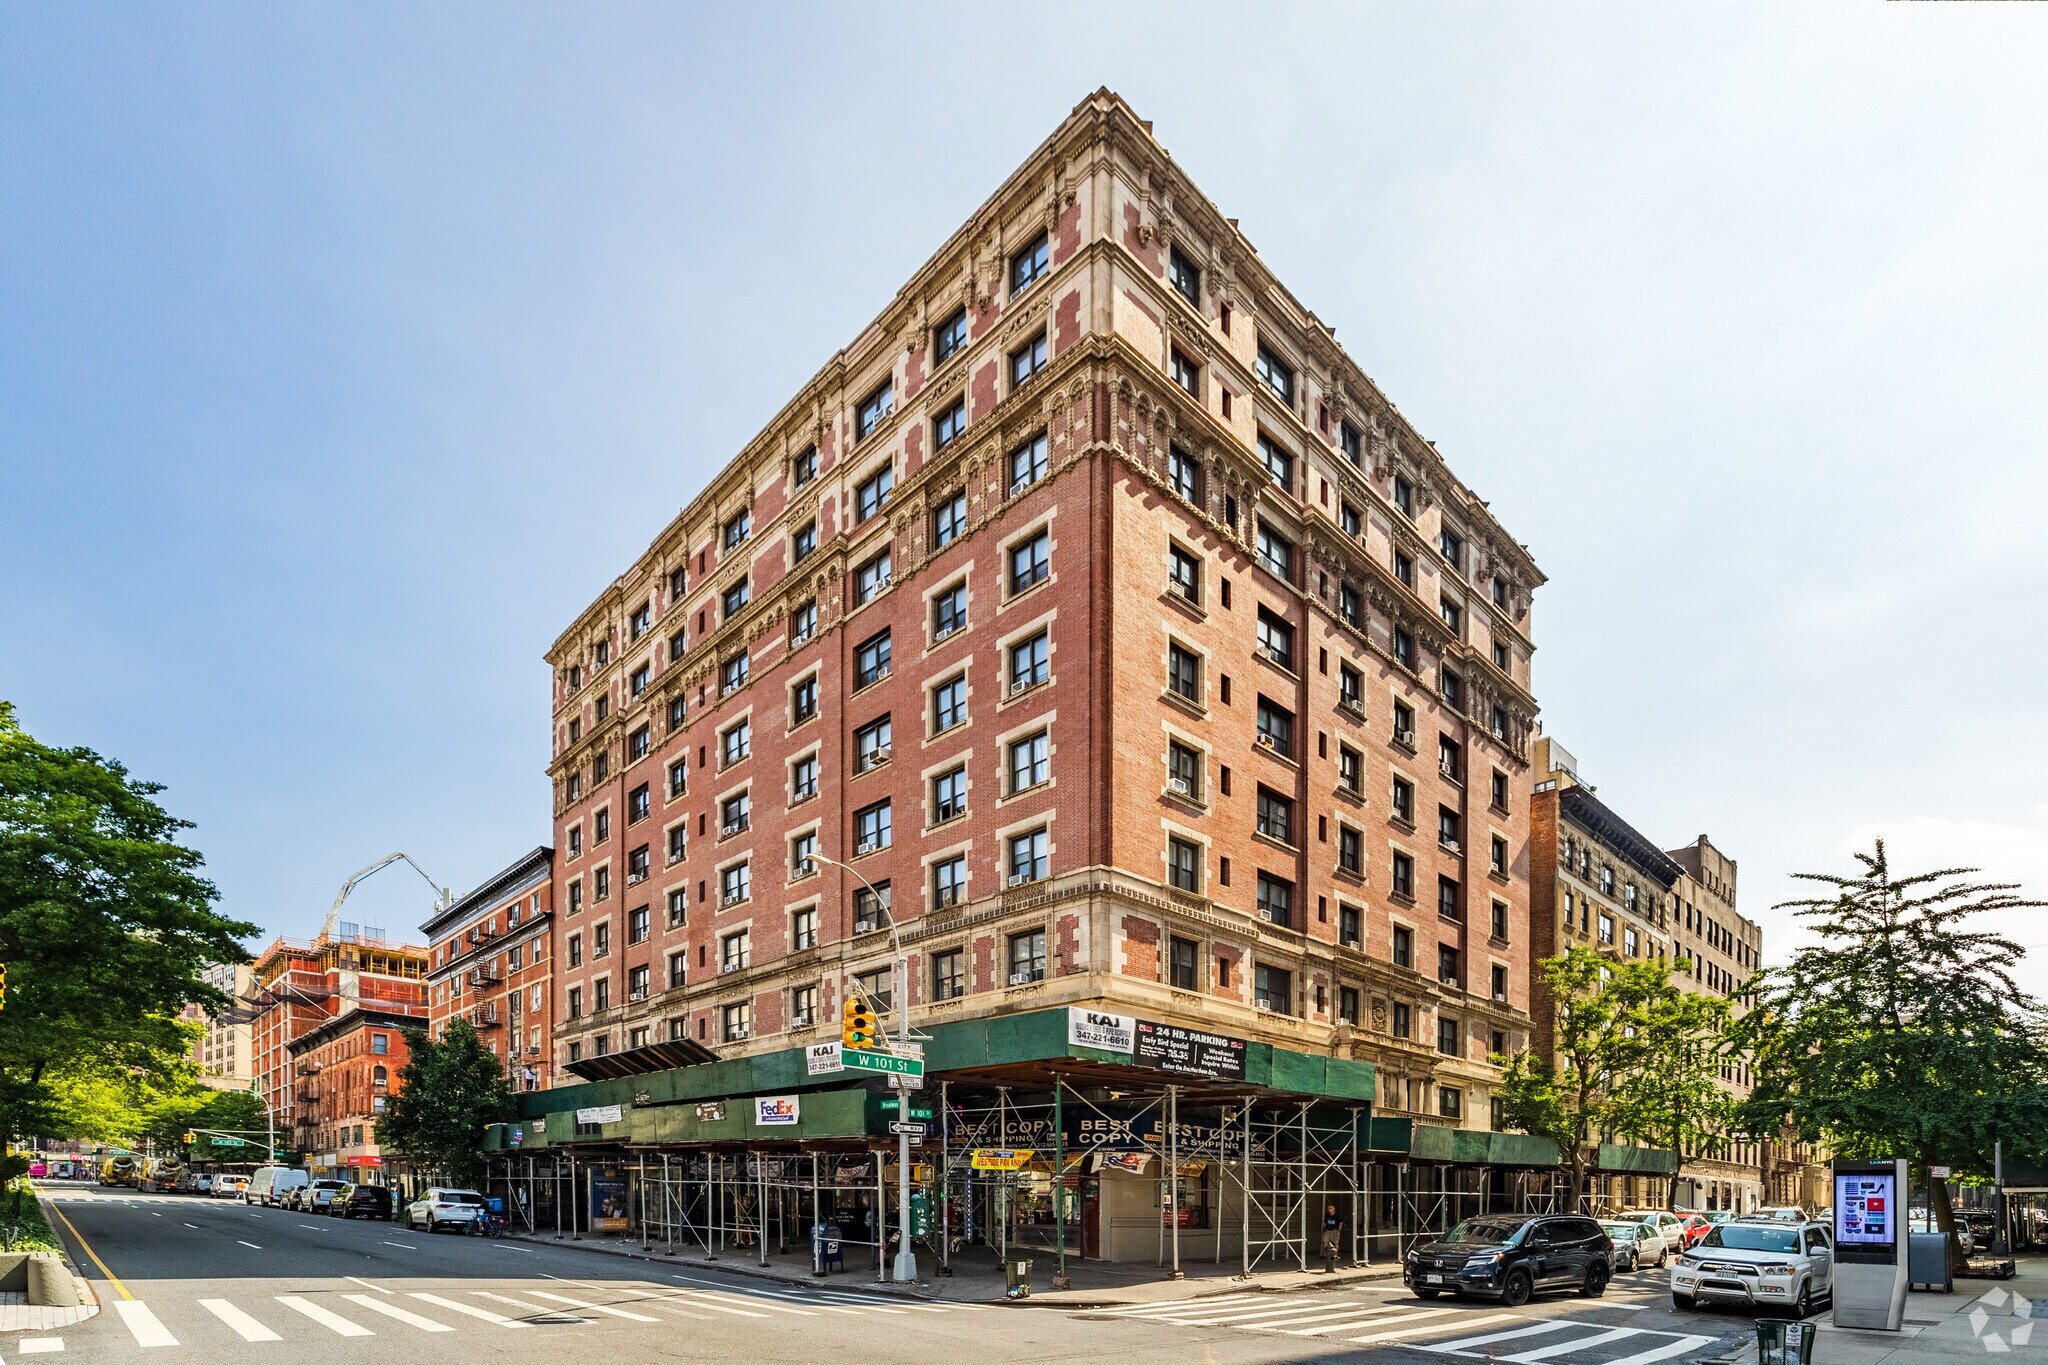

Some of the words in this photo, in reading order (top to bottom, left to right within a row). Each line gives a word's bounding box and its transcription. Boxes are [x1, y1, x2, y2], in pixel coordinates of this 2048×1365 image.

[1087, 1013, 1120, 1028] KAJ
[1076, 1031, 1130, 1046] 347-221-6610
[1142, 1035, 1157, 1046] Early
[1157, 1039, 1169, 1047] Bird
[1170, 1040, 1189, 1050] Special
[1156, 1027, 1170, 1037] 24
[1172, 1030, 1188, 1040] HR.
[1189, 1033, 1229, 1048] PARKING
[813, 1045, 834, 1057] KAJ
[1208, 1048, 1235, 1058] Weekend
[859, 1055, 870, 1066] W
[874, 1057, 893, 1069] 101
[897, 1060, 908, 1072] St
[1201, 1059, 1220, 1068] Inquire
[1222, 1062, 1240, 1071] Within
[1203, 1053, 1222, 1063] Special
[1223, 1057, 1239, 1065] Rates
[1162, 1062, 1175, 1070] Enter
[760, 1099, 793, 1115] FedEx
[955, 1122, 1000, 1136] BEST
[1006, 1119, 1056, 1135] COPY
[1081, 1119, 1134, 1131] BEST
[1154, 1120, 1204, 1138] BEST
[1209, 1128, 1257, 1142] COPY
[985, 1135, 1034, 1144] SHIPPING
[1078, 1132, 1133, 1144] COPY
[1190, 1140, 1239, 1150] SHIPPING
[999, 1157, 1011, 1167] PAK
